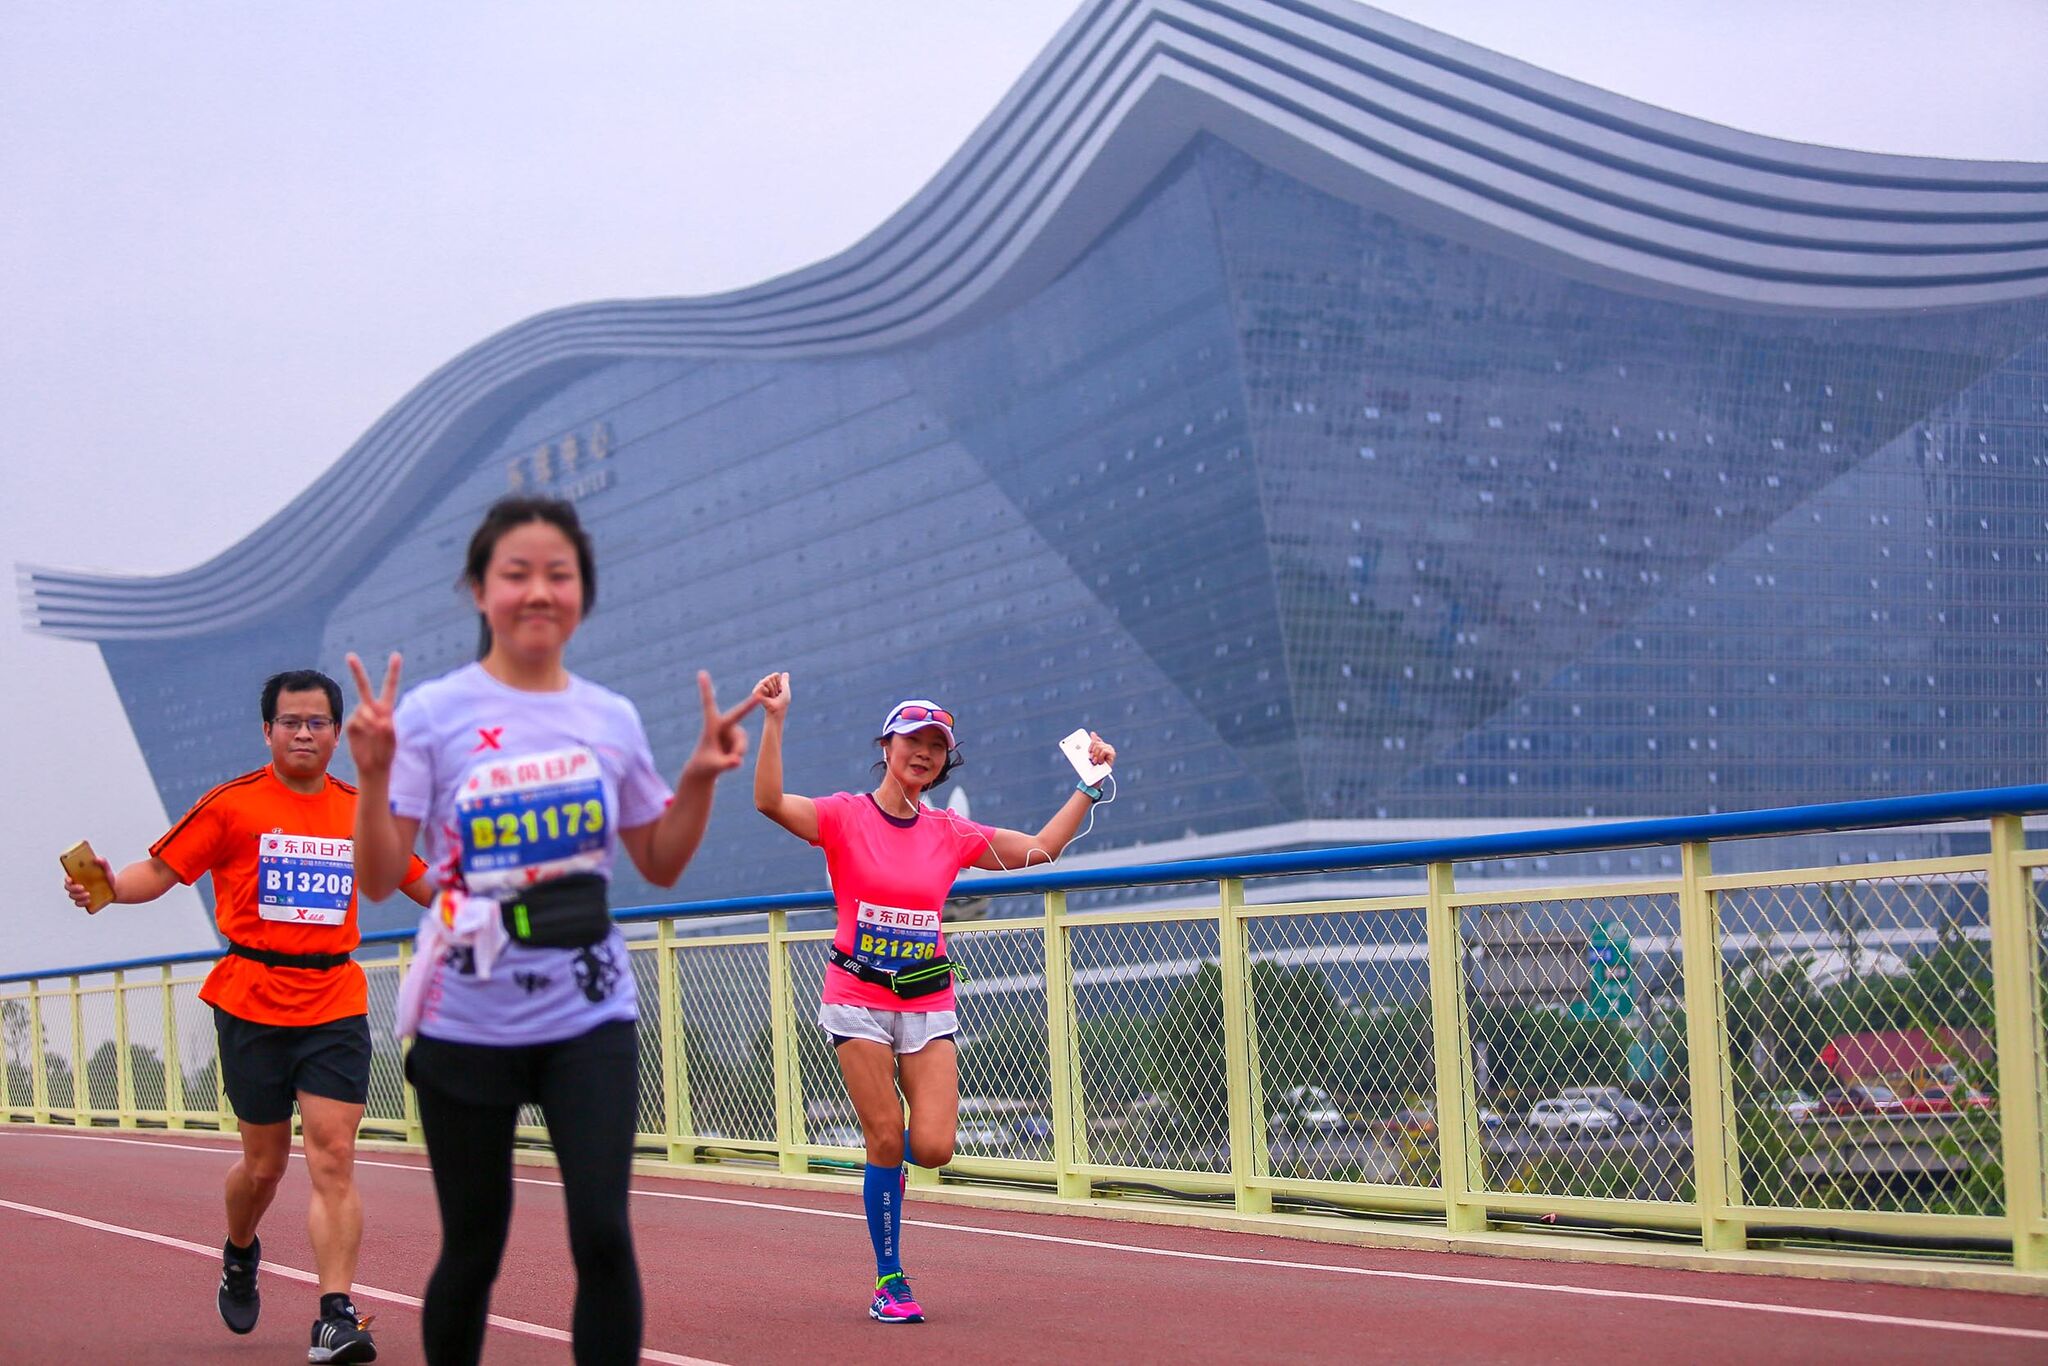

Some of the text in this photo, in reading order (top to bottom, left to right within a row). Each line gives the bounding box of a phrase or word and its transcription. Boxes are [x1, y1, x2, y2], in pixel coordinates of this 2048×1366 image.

[471, 799, 604, 849] B21173
[284, 840, 352, 857] 东风日产
[266, 869, 353, 896] B13208
[879, 910, 935, 927] 东风日产
[860, 933, 936, 960] B21236
[883, 1191, 891, 1210] EAR
